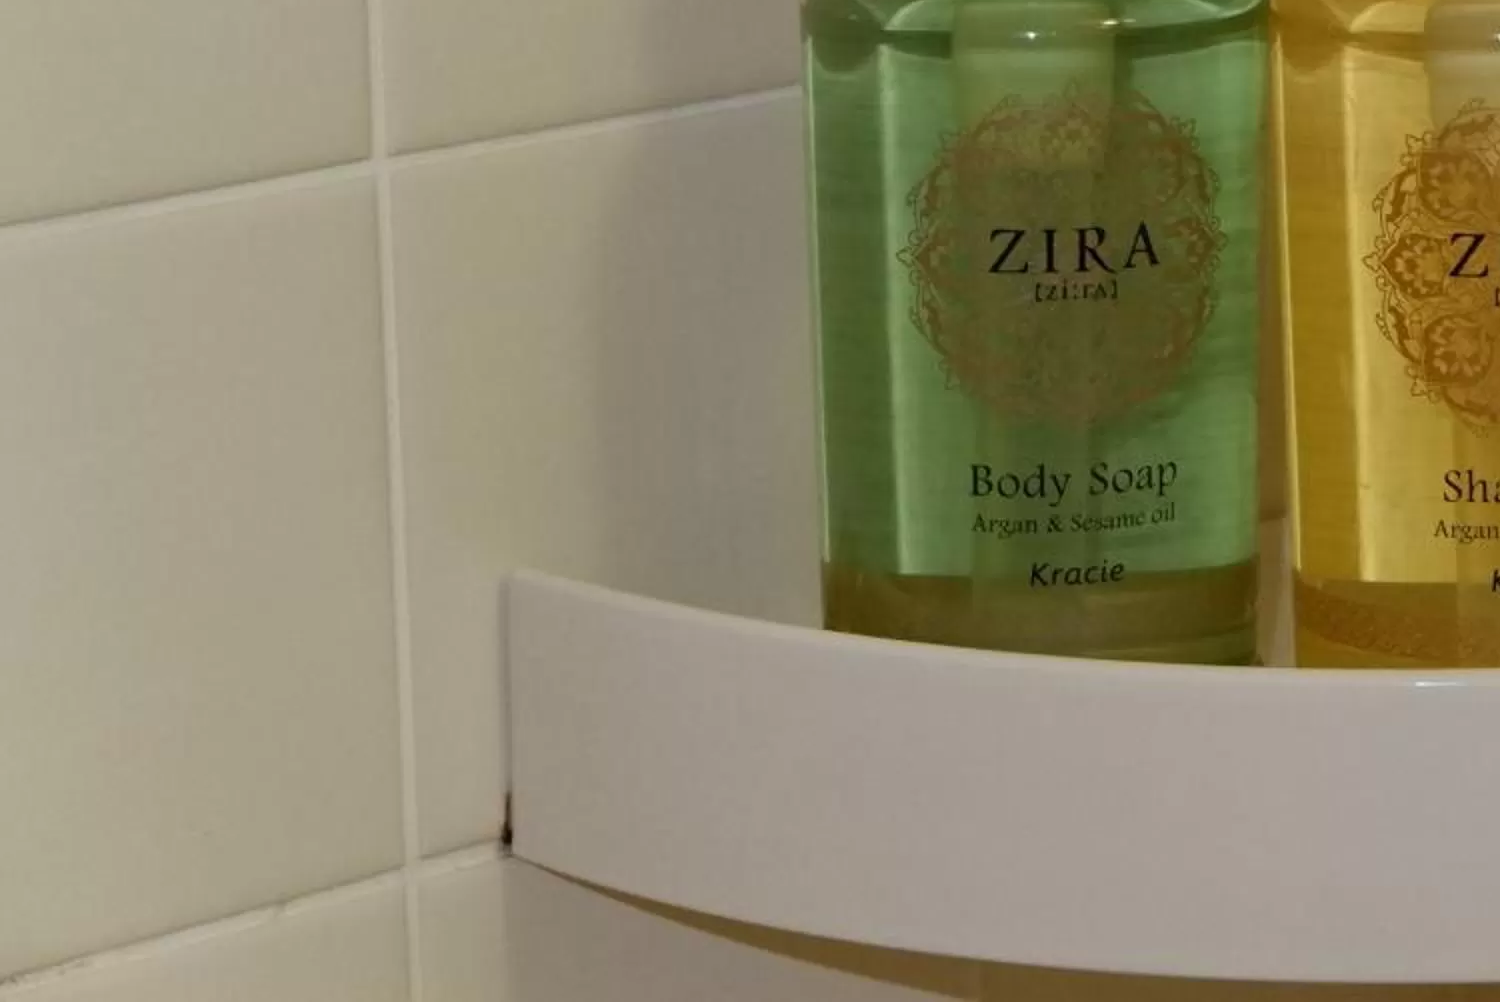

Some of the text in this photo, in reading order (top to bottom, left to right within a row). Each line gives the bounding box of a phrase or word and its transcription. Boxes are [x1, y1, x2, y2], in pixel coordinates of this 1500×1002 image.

[988, 219, 1161, 274] ZIRA
[970, 460, 1178, 507] Body Soap
[971, 501, 1176, 539] Argan & Sesame oil
[1433, 518, 1500, 544] Argan
[1029, 558, 1126, 588] Kracie
